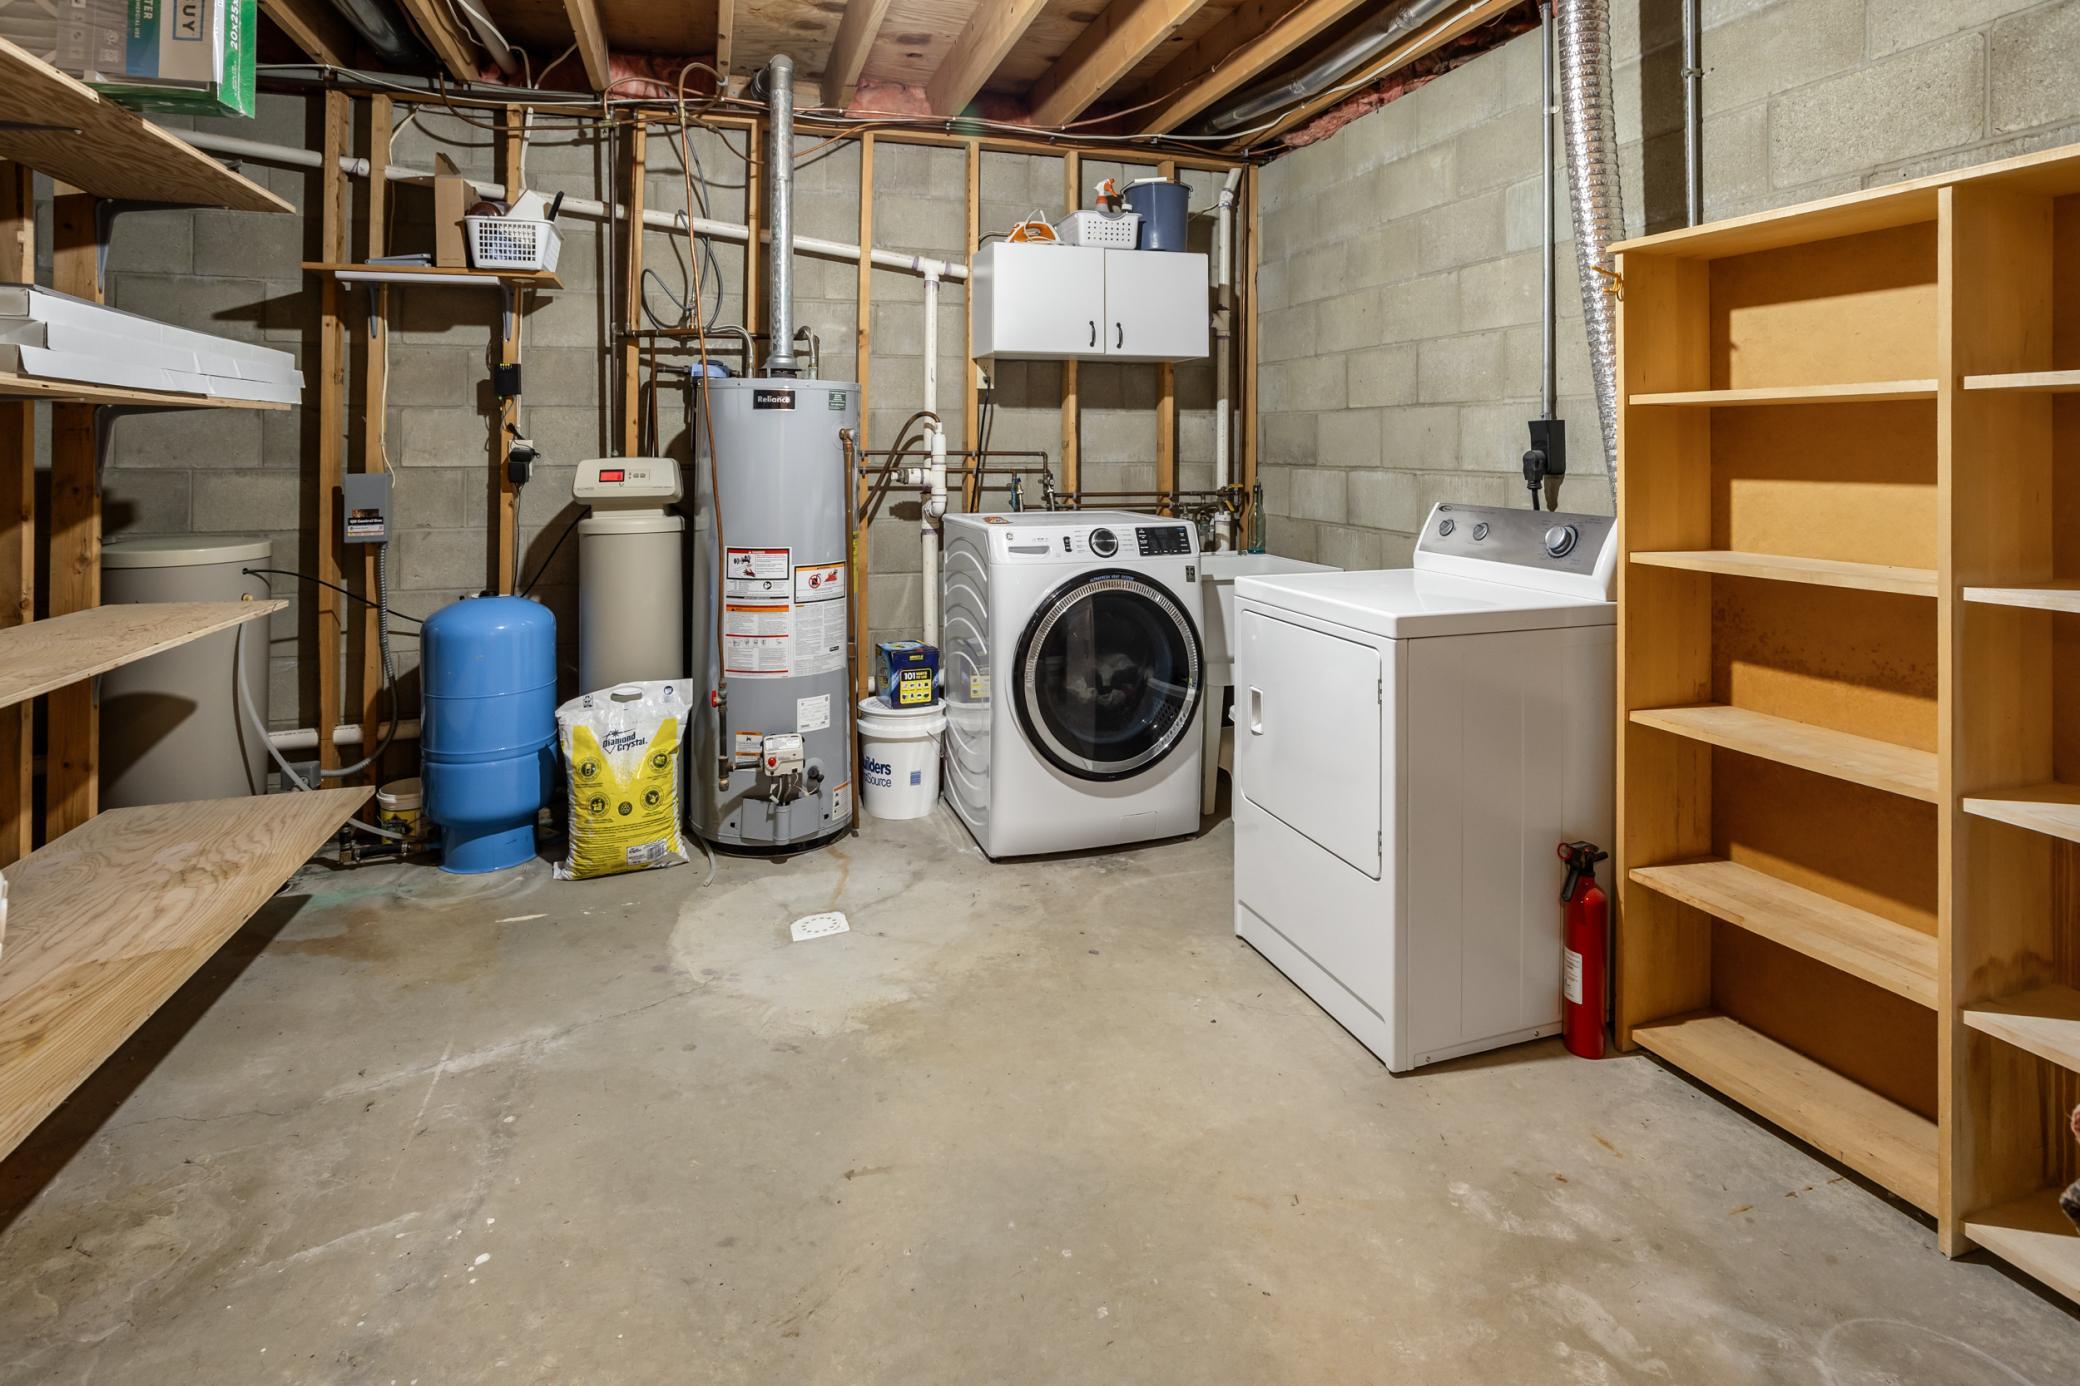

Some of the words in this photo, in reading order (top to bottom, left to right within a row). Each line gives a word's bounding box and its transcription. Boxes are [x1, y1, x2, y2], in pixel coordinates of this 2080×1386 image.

[182, 0, 196, 32] UY
[757, 395, 791, 403] Reliance
[904, 672, 916, 680] 101
[603, 731, 635, 748] Diamond
